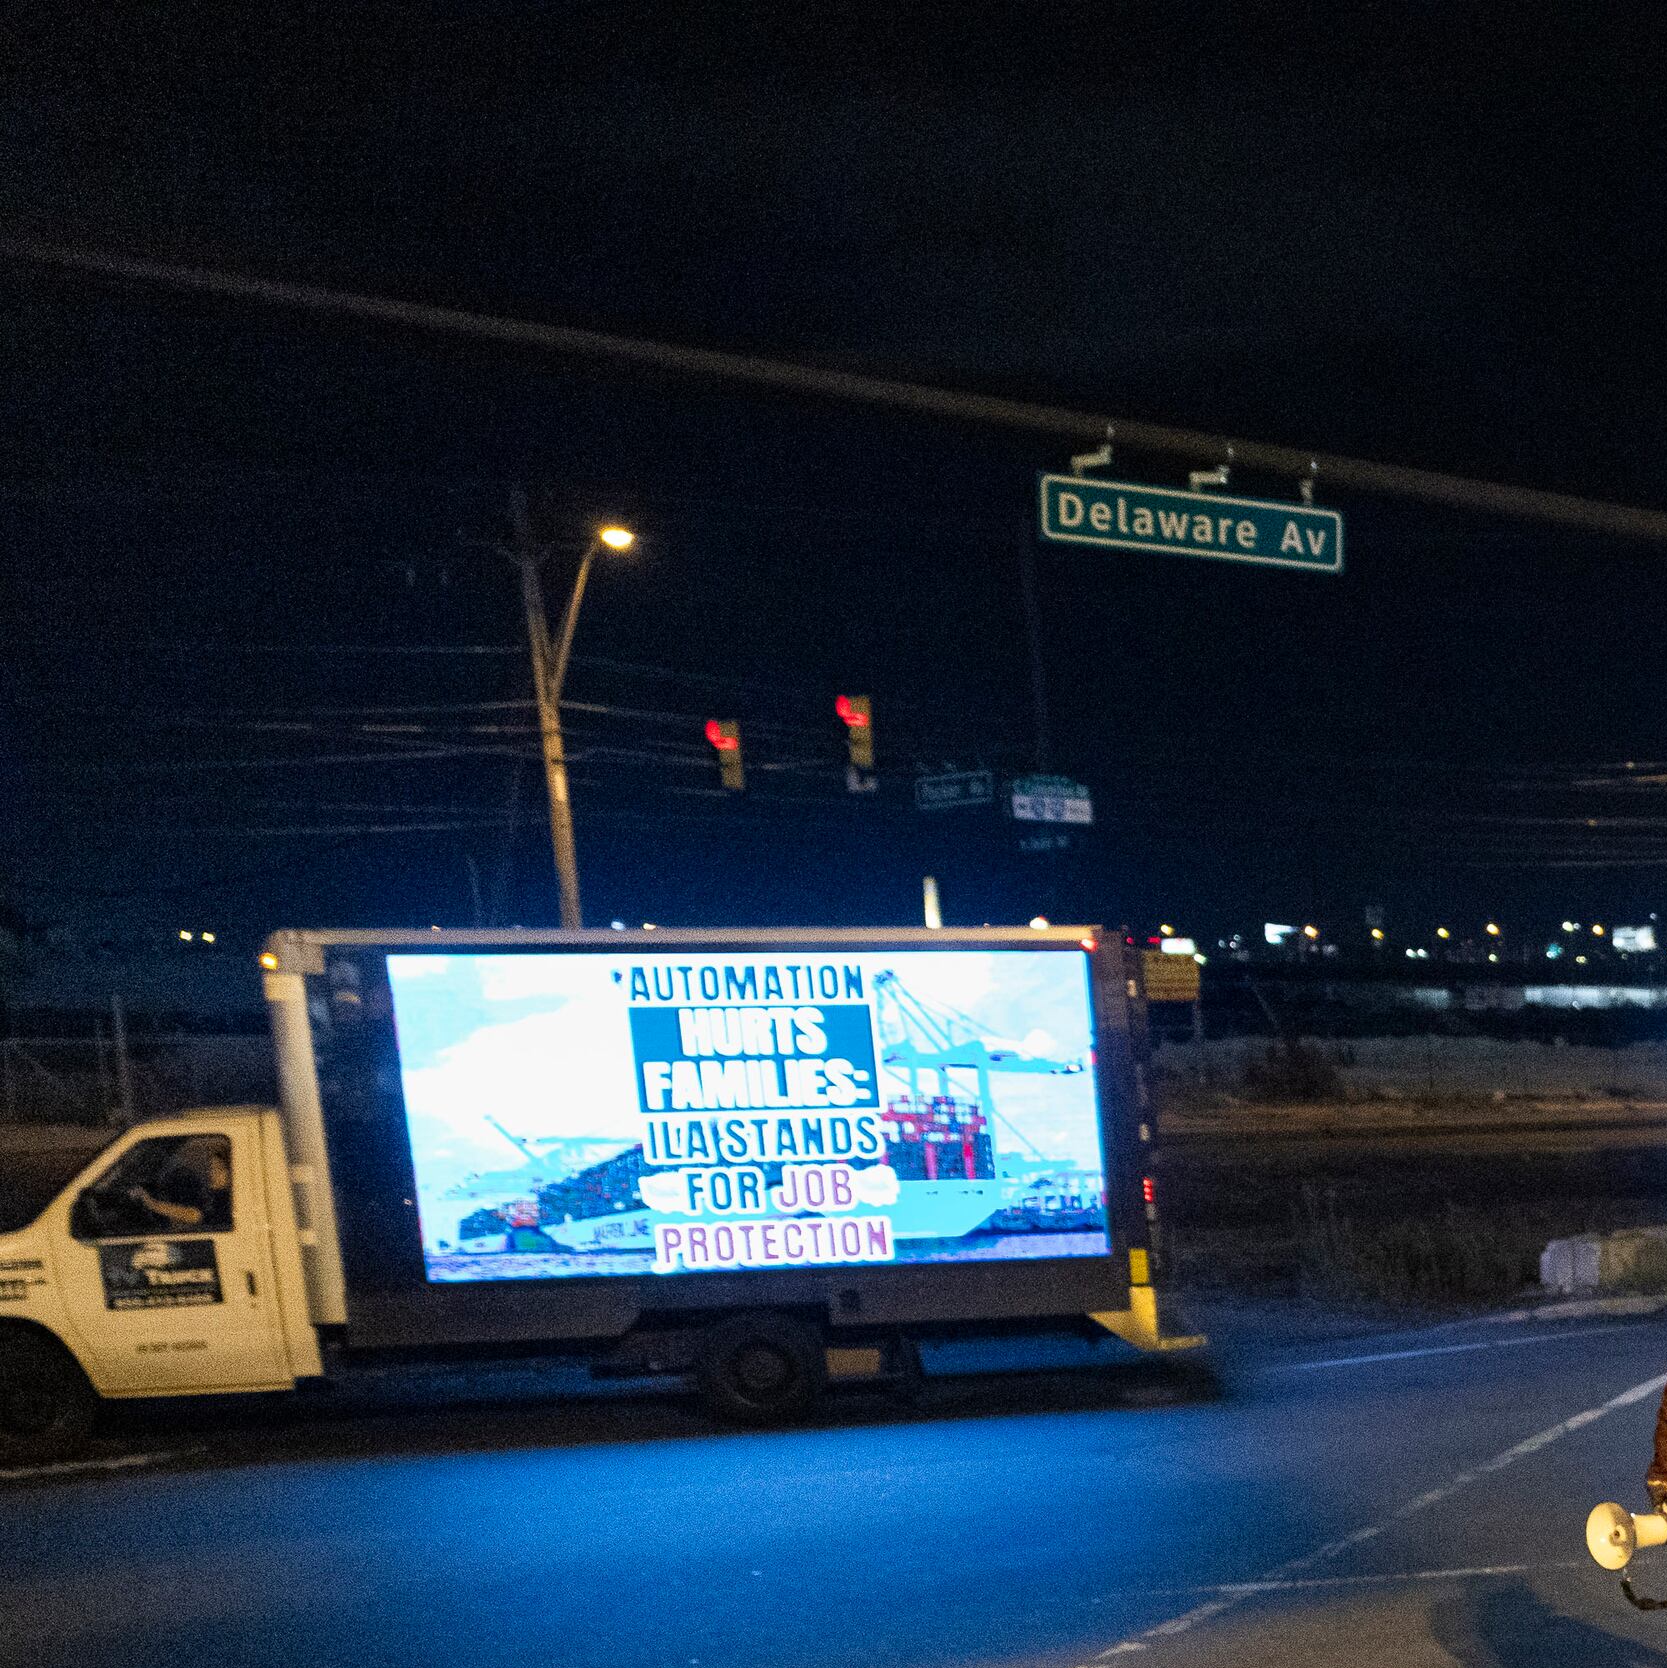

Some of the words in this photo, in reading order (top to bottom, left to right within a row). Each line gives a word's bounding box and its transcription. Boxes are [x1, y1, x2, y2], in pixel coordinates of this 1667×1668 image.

[1058, 491, 1258, 548] Delaware
[1281, 520, 1326, 556] Av
[630, 964, 864, 1001] AUTOMATION
[678, 1007, 827, 1056] HURTS
[643, 1059, 872, 1110] FAMILIES:
[648, 1120, 711, 1160] ILA
[721, 1116, 878, 1158] STANDS
[686, 1171, 760, 1211] FOR
[778, 1169, 853, 1207] JOB
[662, 1220, 887, 1264] PROTECTION
